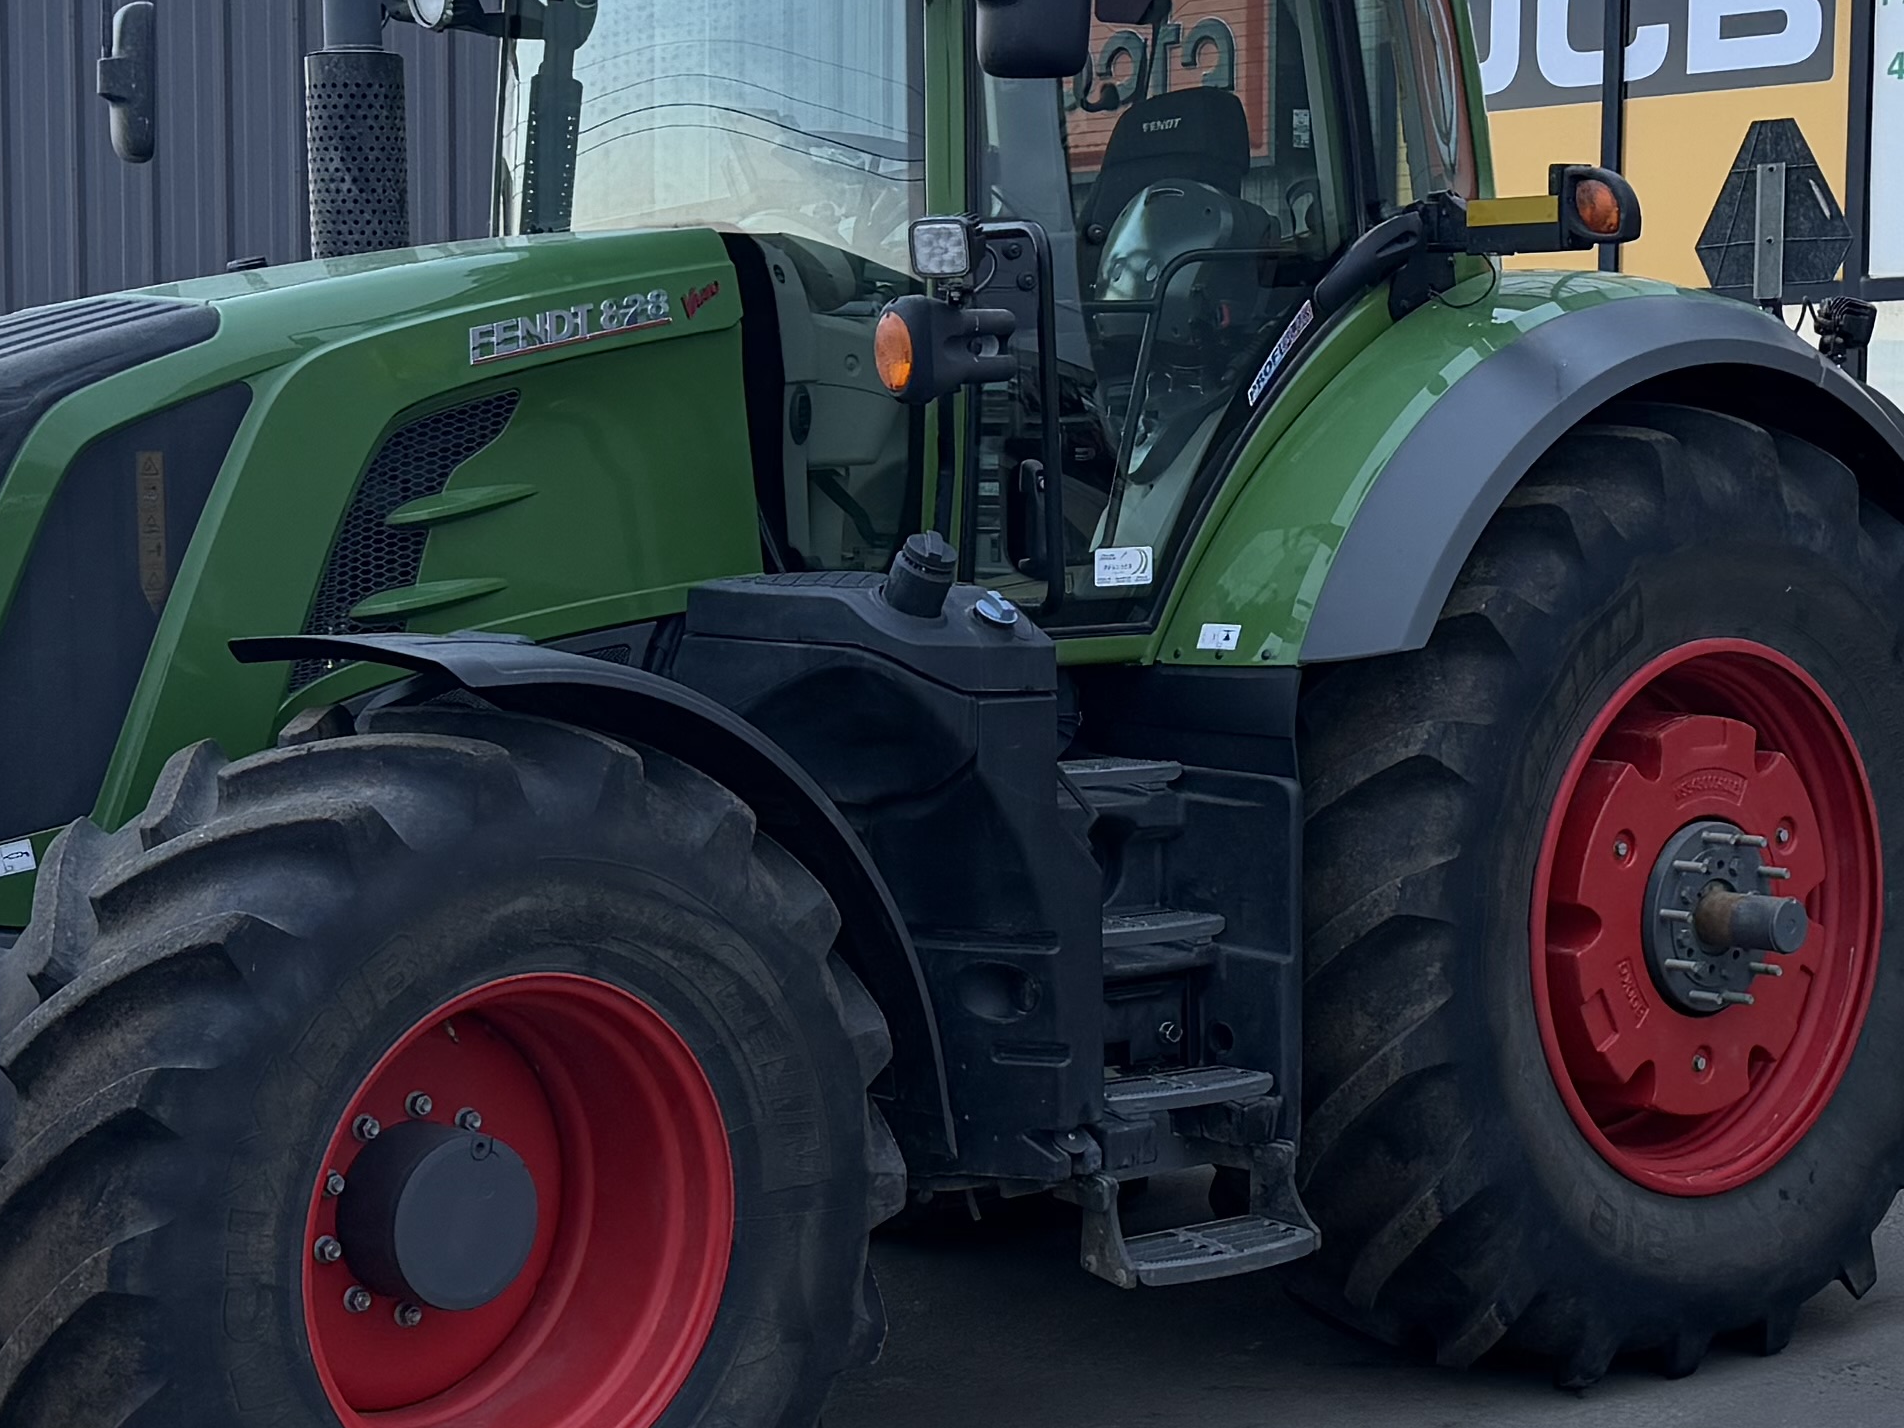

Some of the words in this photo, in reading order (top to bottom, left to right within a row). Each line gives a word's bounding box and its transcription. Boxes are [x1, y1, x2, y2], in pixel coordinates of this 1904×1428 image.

[1142, 117, 1181, 133] FENDT
[469, 303, 593, 364] FENDT
[600, 289, 669, 330] 828
